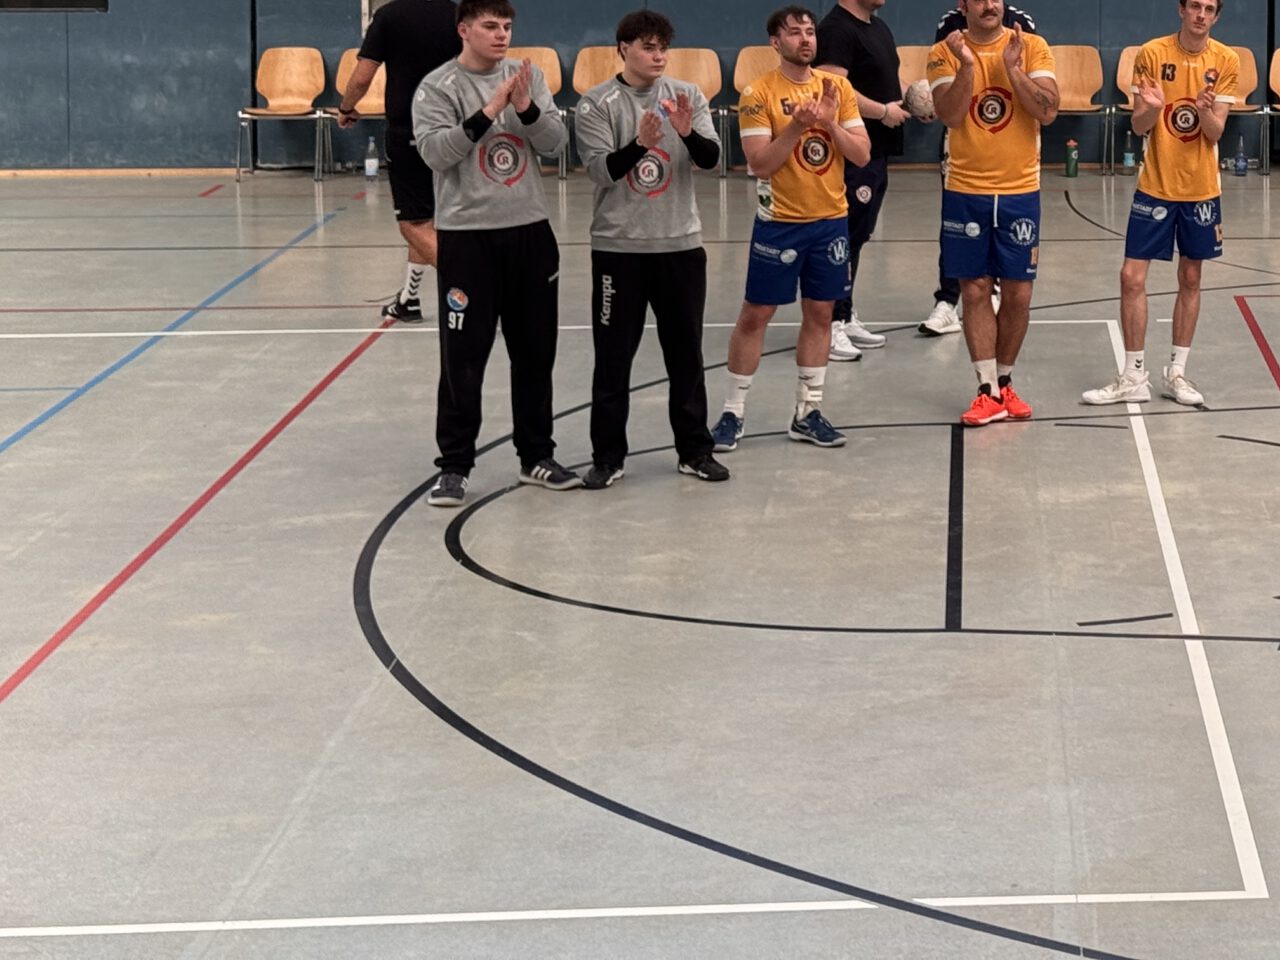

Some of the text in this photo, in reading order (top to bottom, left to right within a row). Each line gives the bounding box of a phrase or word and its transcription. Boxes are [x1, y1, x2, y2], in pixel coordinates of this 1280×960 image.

[1160, 62, 1176, 82] 13
[600, 274, 616, 327] Kempa
[448, 312, 465, 331] 97
